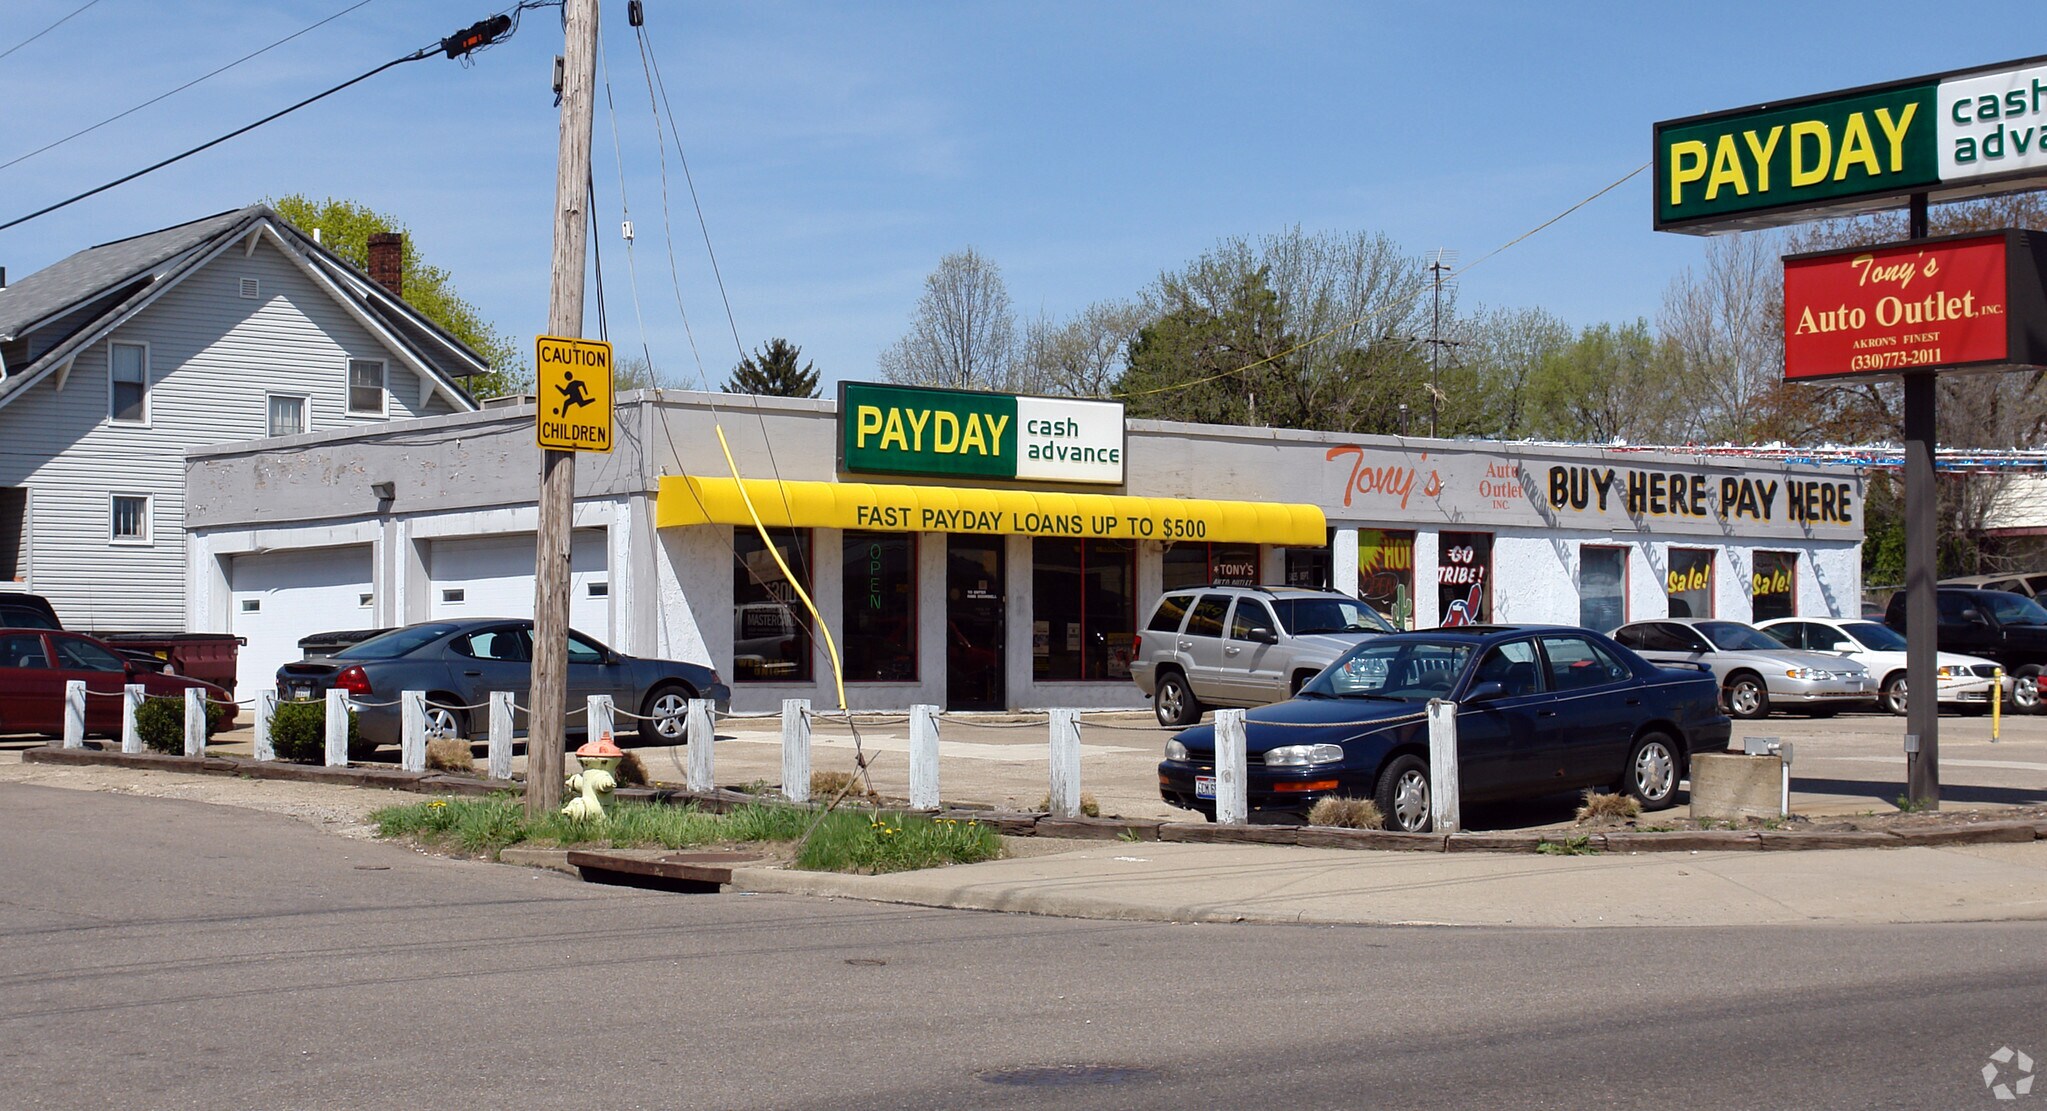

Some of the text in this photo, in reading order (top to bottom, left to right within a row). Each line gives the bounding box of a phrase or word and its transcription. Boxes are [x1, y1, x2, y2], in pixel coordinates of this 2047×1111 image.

[1671, 102, 1919, 206] PAYDAY
[1851, 251, 1939, 289] Tony's
[1794, 305, 1866, 335] Auto
[1981, 304, 2004, 316] INC.
[1853, 331, 1940, 349] AKRON'S FINEST
[542, 346, 606, 368] CAUTION
[1851, 347, 1941, 372] (330)773-2011
[542, 421, 606, 443] CHILDREN
[857, 405, 1009, 457] PAYDAY
[1027, 417, 1079, 438] cash
[1028, 440, 1119, 464] advance
[1325, 444, 1441, 510] Tony's
[1485, 460, 1519, 478] Auto
[1479, 479, 1524, 499] Outlet
[1548, 466, 1853, 526] BUY HERE PAY HERE
[1492, 500, 1510, 510] INC.
[857, 505, 1206, 539] FAST PAYDAY LOANS UP TO $500
[1449, 546, 1474, 563] GO
[870, 543, 881, 609] OPEN
[1219, 562, 1254, 576] TONY'S
